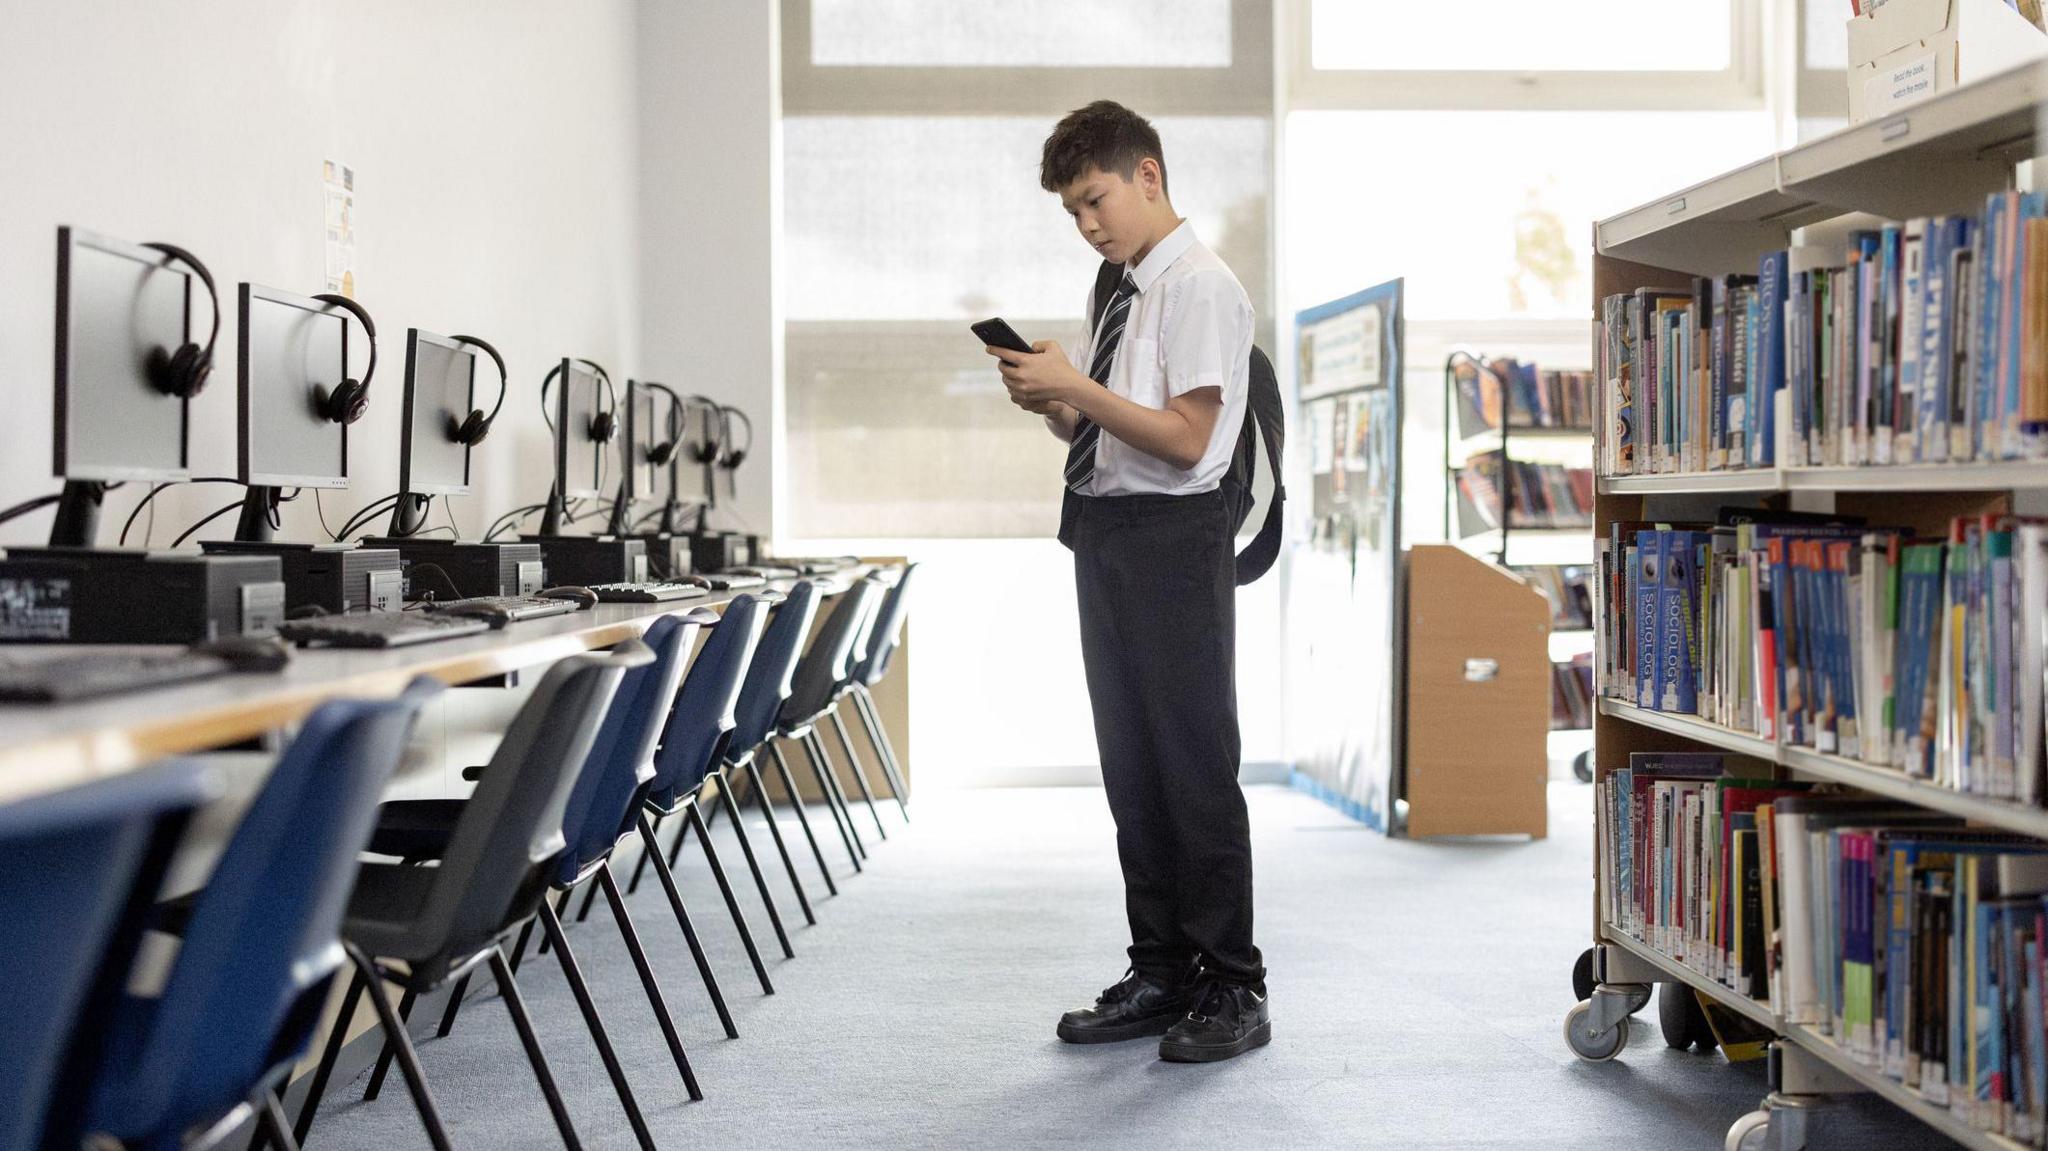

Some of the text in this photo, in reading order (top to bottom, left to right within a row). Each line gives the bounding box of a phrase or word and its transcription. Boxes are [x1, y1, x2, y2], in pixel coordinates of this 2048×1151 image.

[1762, 257, 1775, 335] GROSS
[1733, 315, 1746, 384] PSYCHOLOGY
[1668, 594, 1681, 686] SOCIOLOGY
